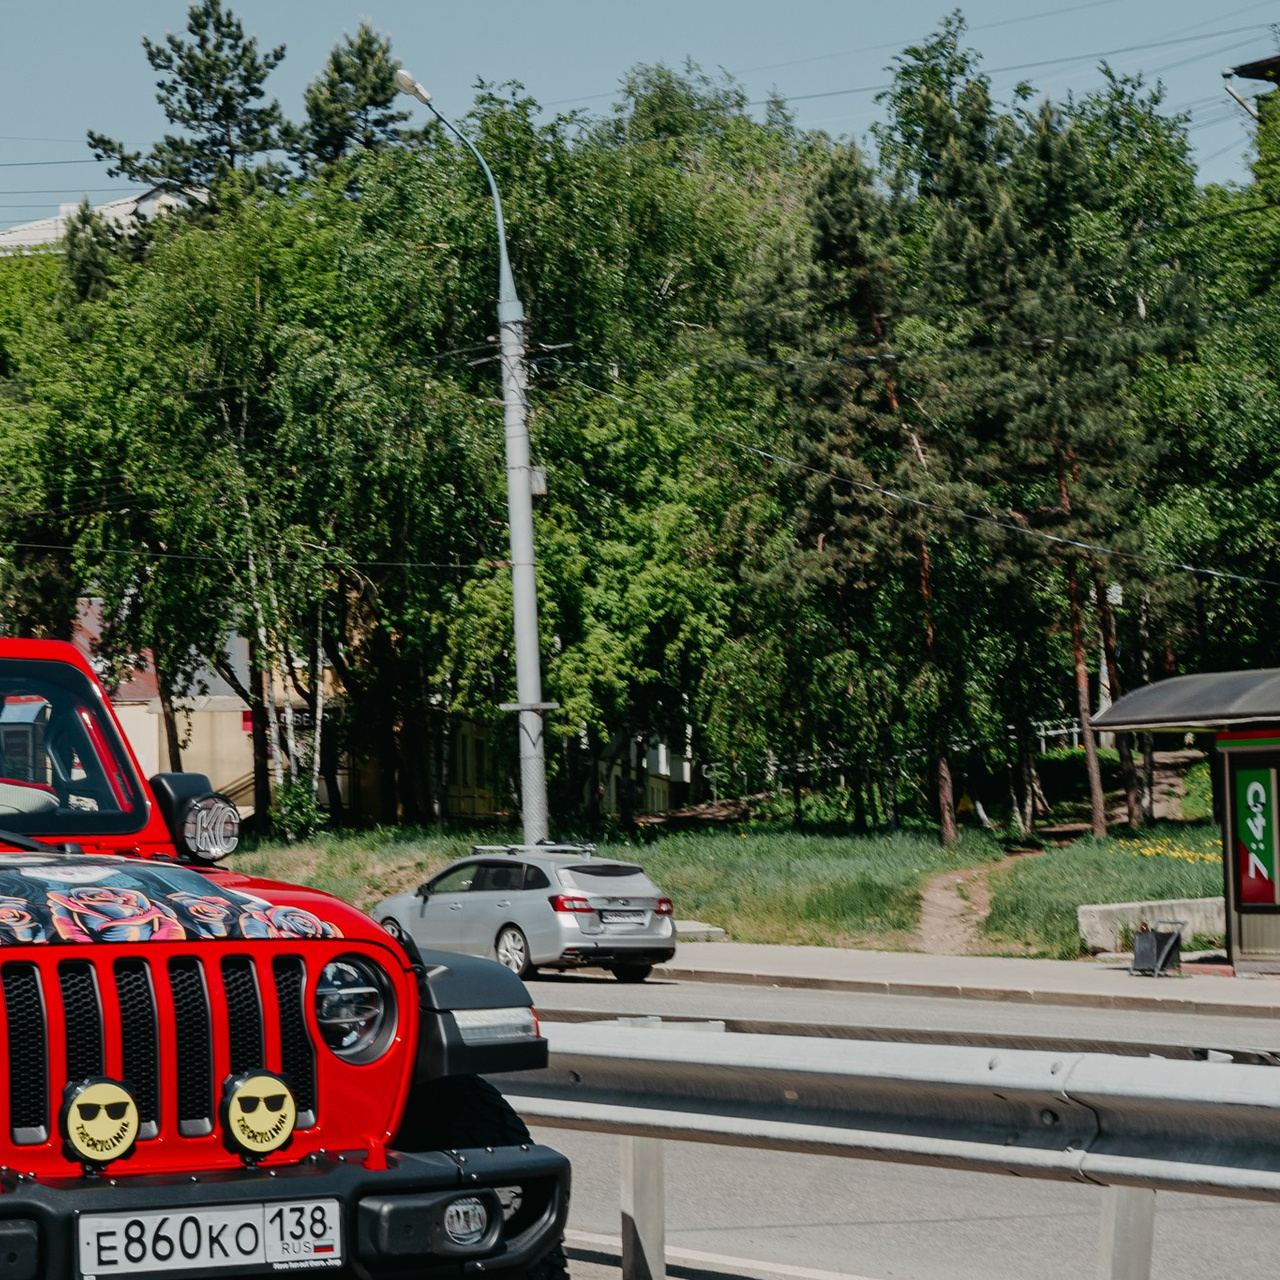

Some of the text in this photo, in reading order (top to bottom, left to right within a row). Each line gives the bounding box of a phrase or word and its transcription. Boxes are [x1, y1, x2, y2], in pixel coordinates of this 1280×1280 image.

[196, 803, 240, 854] KC
[86, 1122, 129, 1152] ORIGINAL
[246, 1113, 287, 1144] ORIGINAL
[268, 1205, 327, 1242] 138
[281, 1240, 312, 1255] RUS
